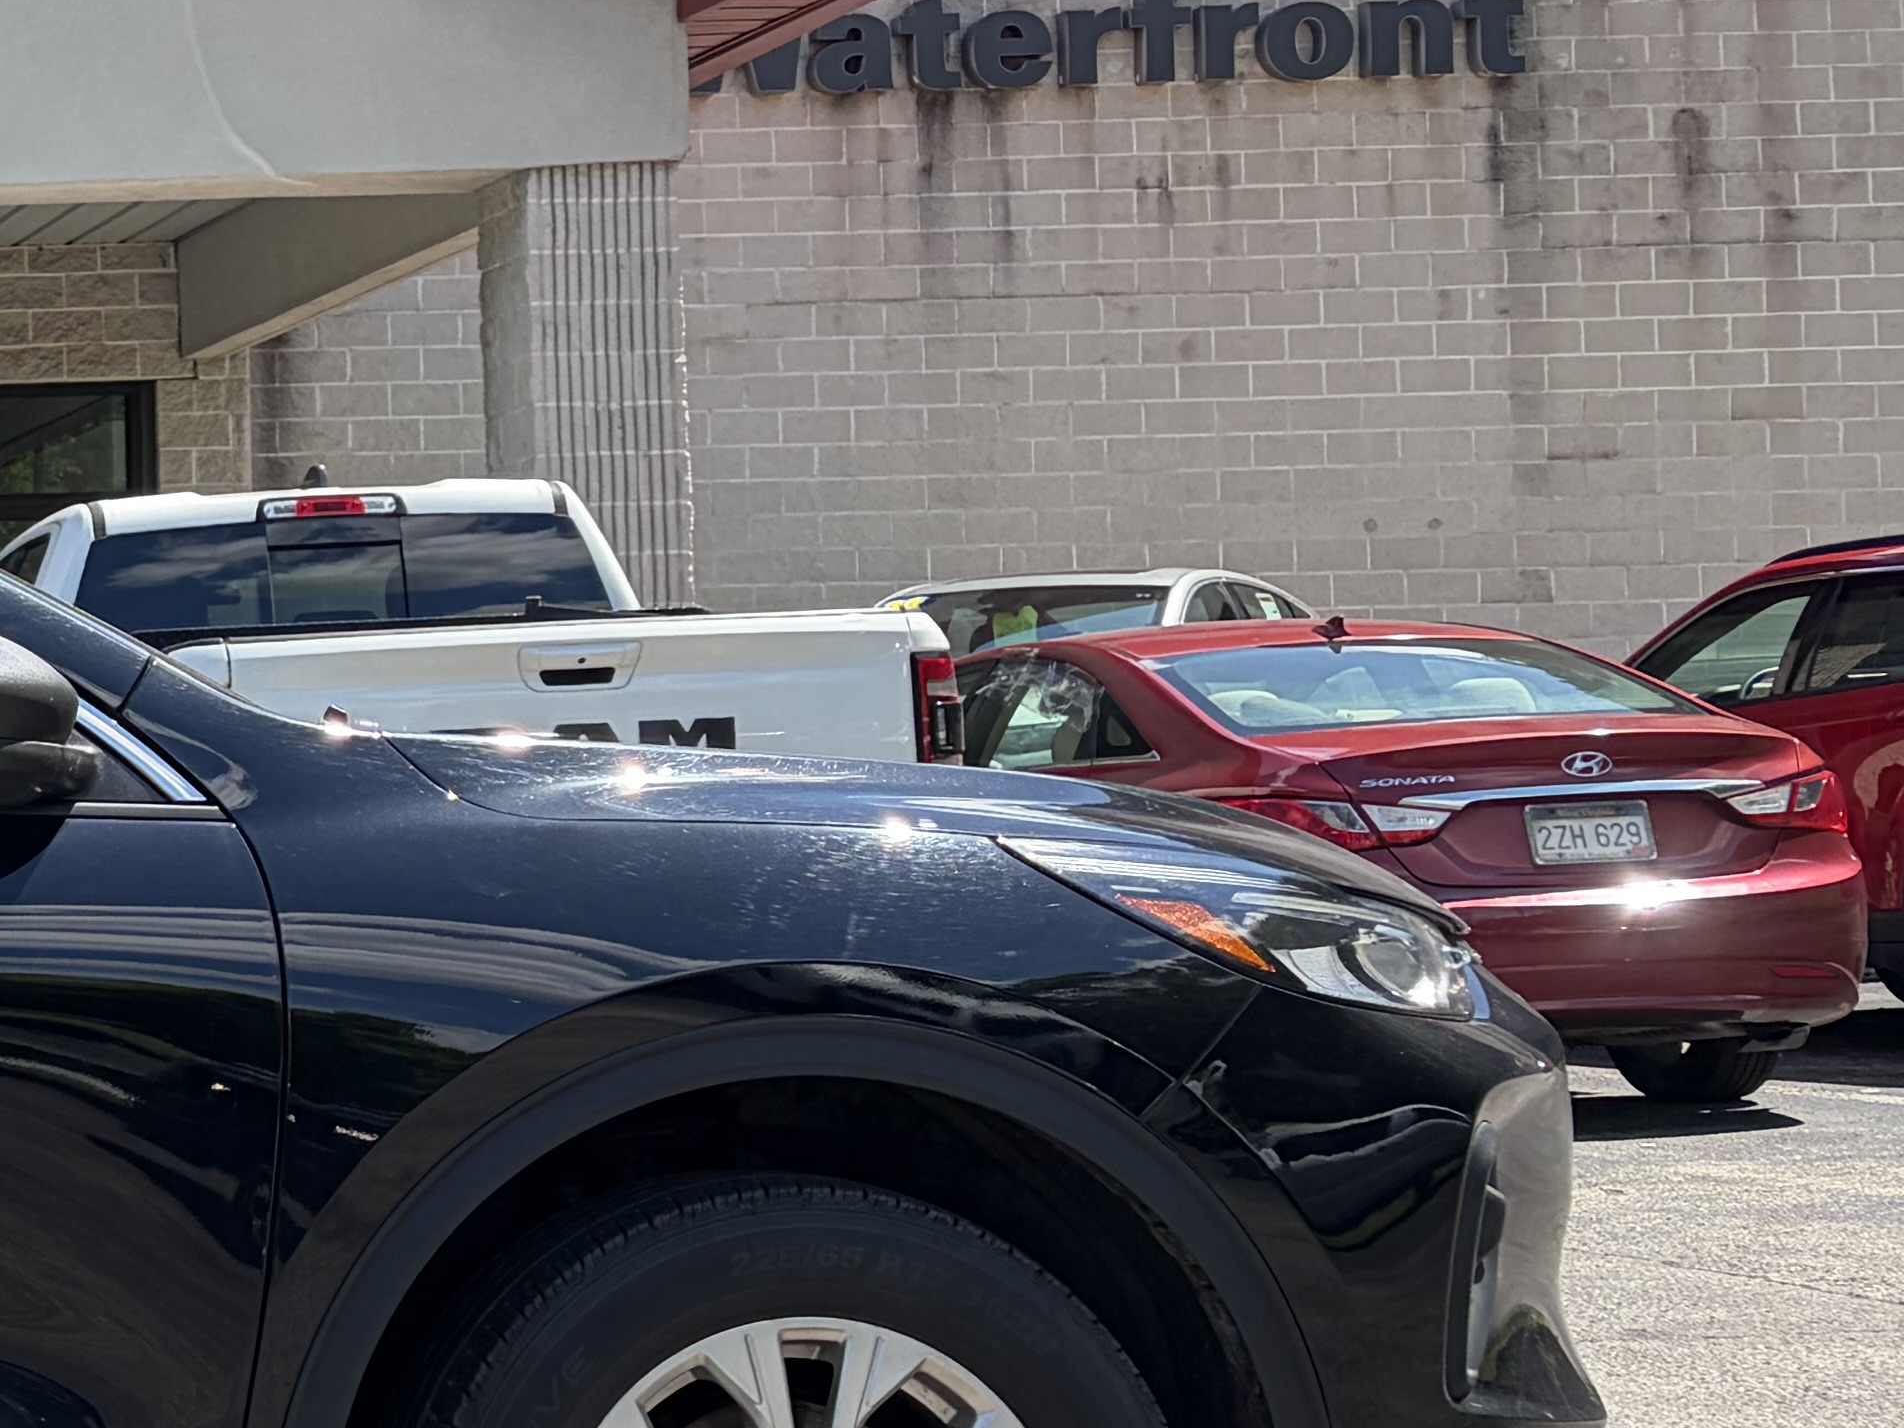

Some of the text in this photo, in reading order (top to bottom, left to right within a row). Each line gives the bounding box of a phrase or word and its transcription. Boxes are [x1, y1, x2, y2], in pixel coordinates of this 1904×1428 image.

[1359, 775, 1455, 788] SONATA
[1538, 822, 1642, 850] 2ZH 629
